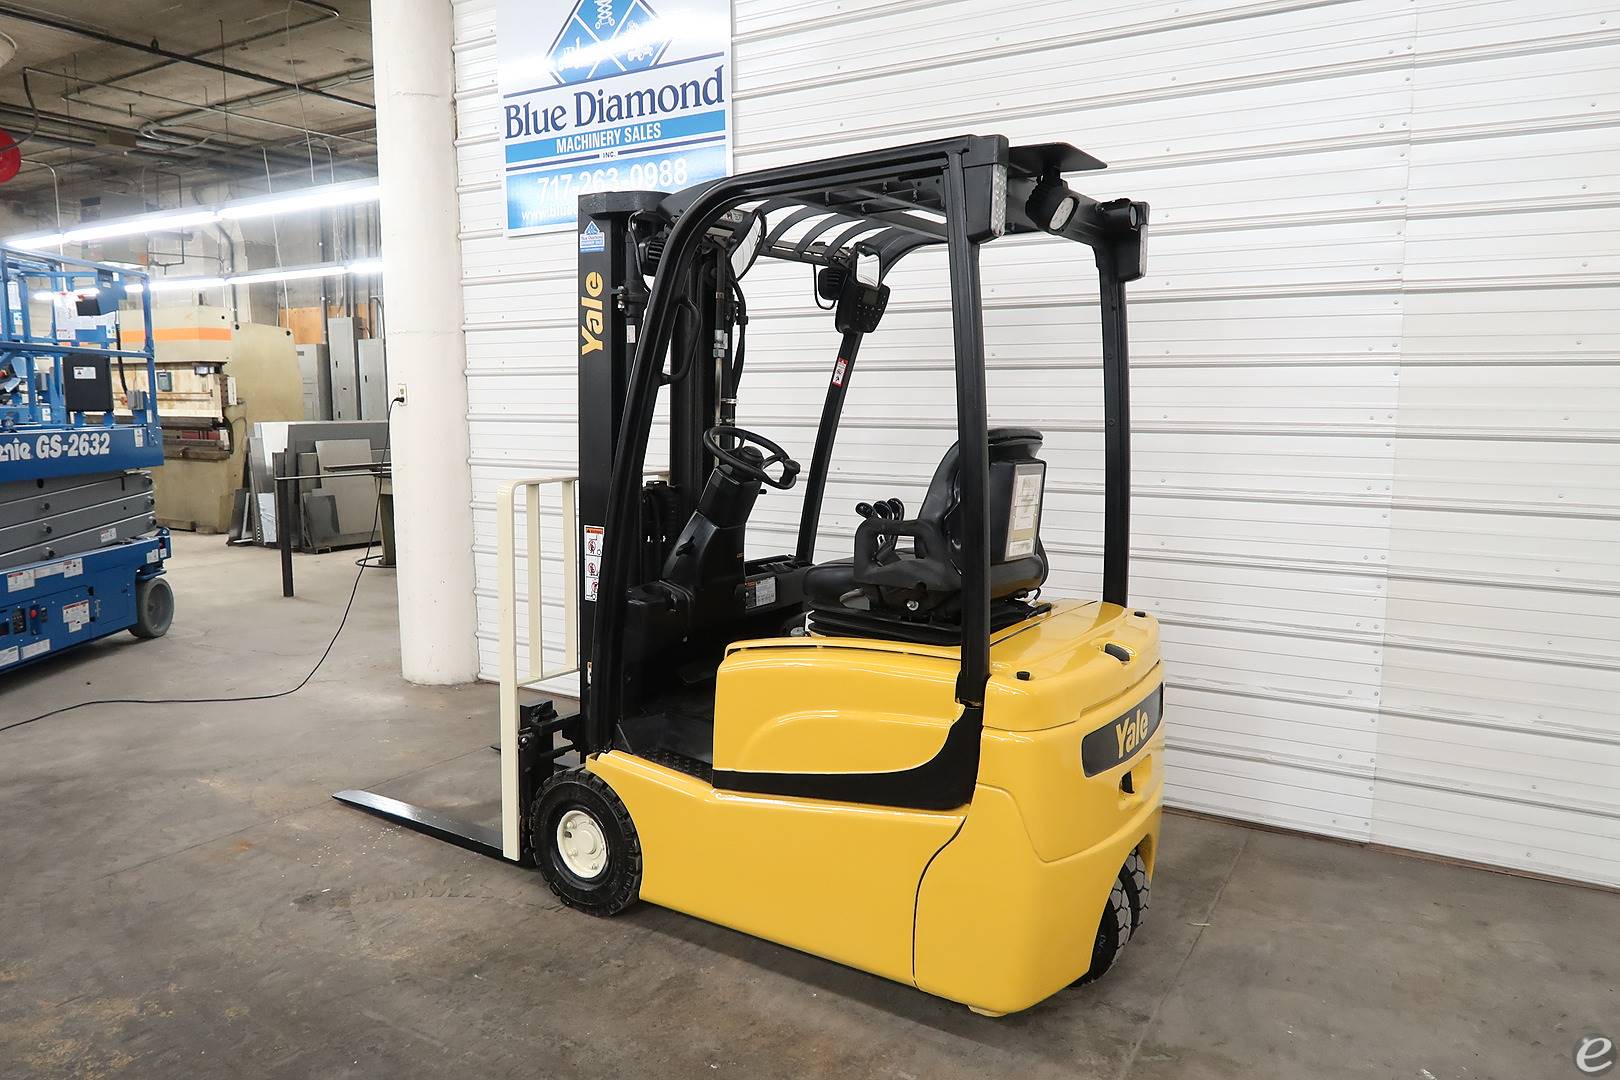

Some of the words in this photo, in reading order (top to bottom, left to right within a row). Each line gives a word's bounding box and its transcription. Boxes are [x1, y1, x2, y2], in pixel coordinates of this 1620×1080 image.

[504, 101, 567, 139] Blue
[573, 65, 725, 127] Diamond
[556, 129, 623, 154] MACHINERY
[625, 122, 662, 143] SALES
[537, 157, 688, 206] 717-263-0988
[581, 271, 604, 356] Yale
[36, 432, 110, 459] GS-2632
[1115, 709, 1149, 759] Yale
